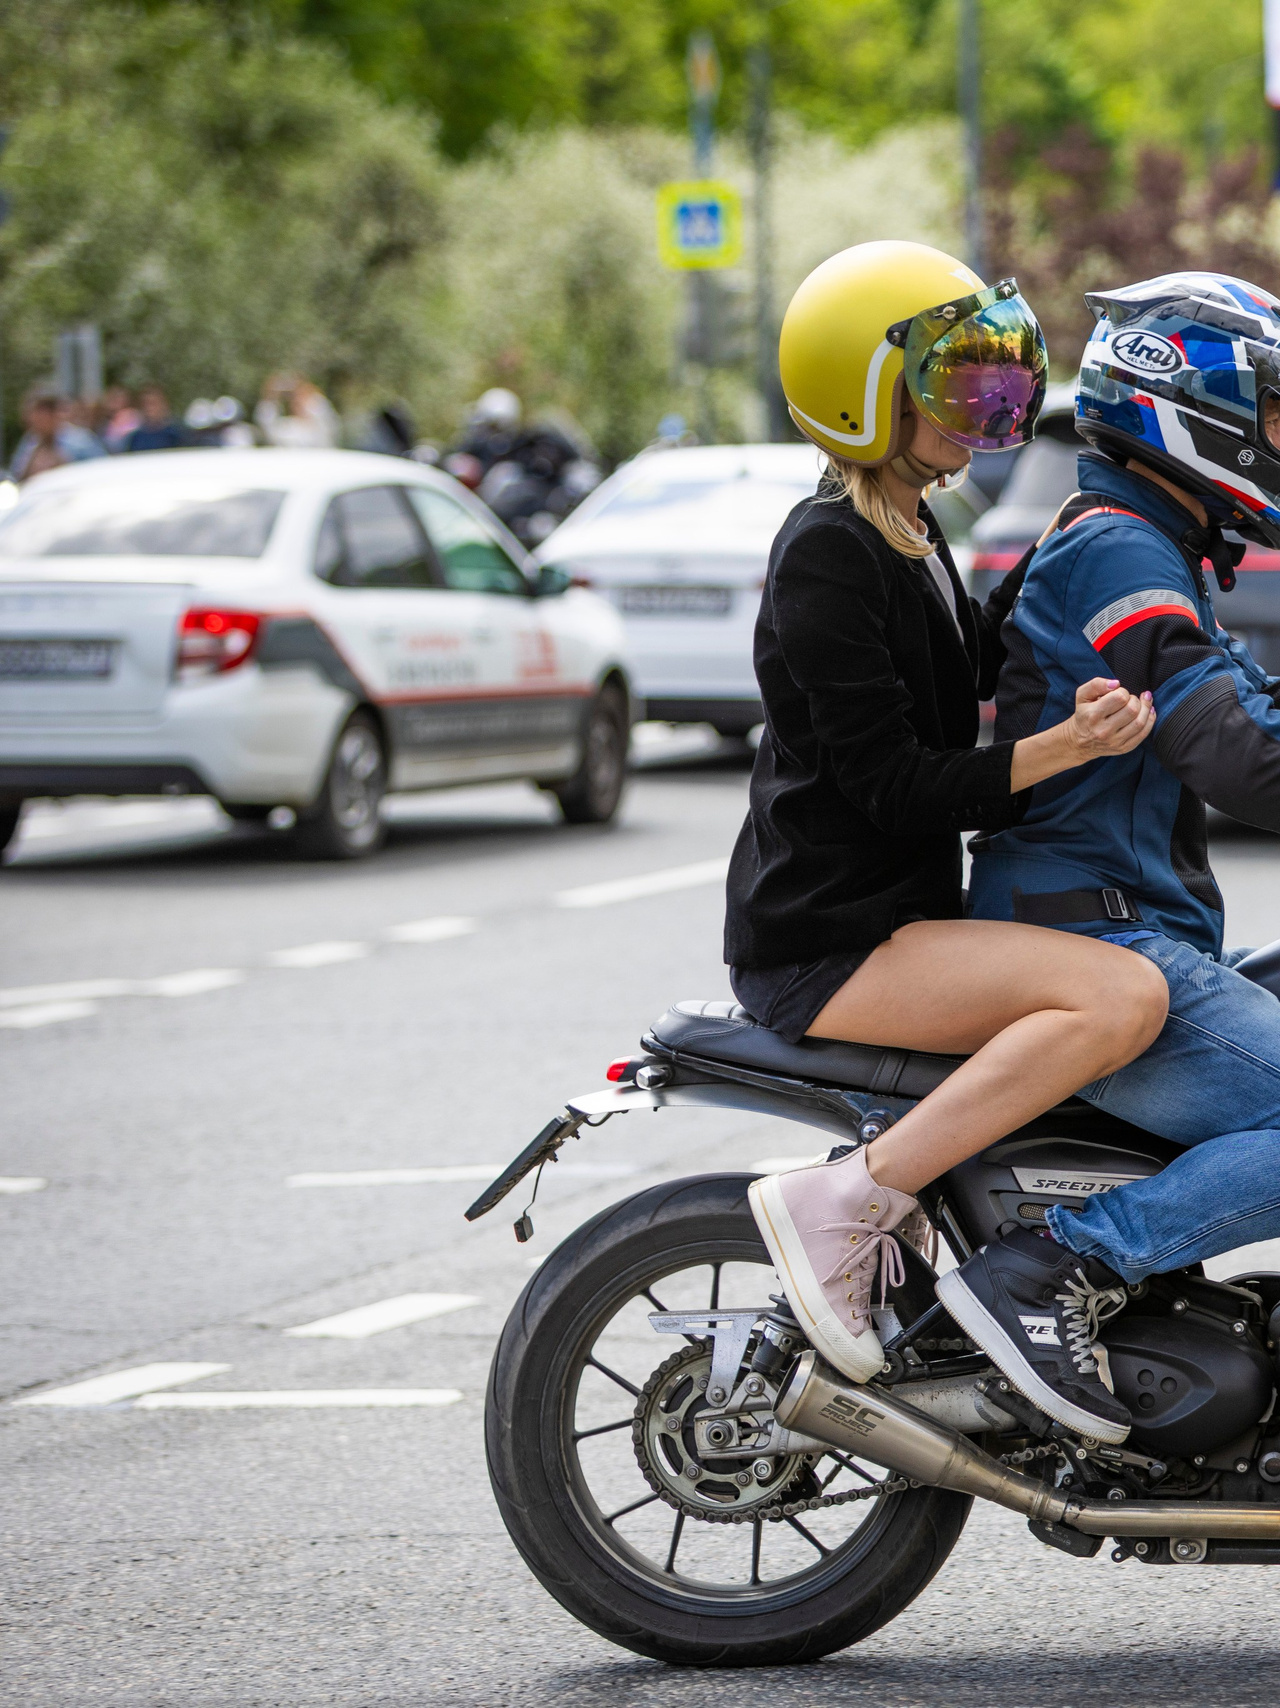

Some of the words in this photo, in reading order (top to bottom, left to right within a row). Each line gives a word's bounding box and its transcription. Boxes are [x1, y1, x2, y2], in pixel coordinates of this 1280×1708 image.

[1114, 335, 1175, 367] Arai
[1032, 1179, 1097, 1192] SPEED
[820, 1406, 873, 1433] PROJECT
[826, 1394, 886, 1429] SC
